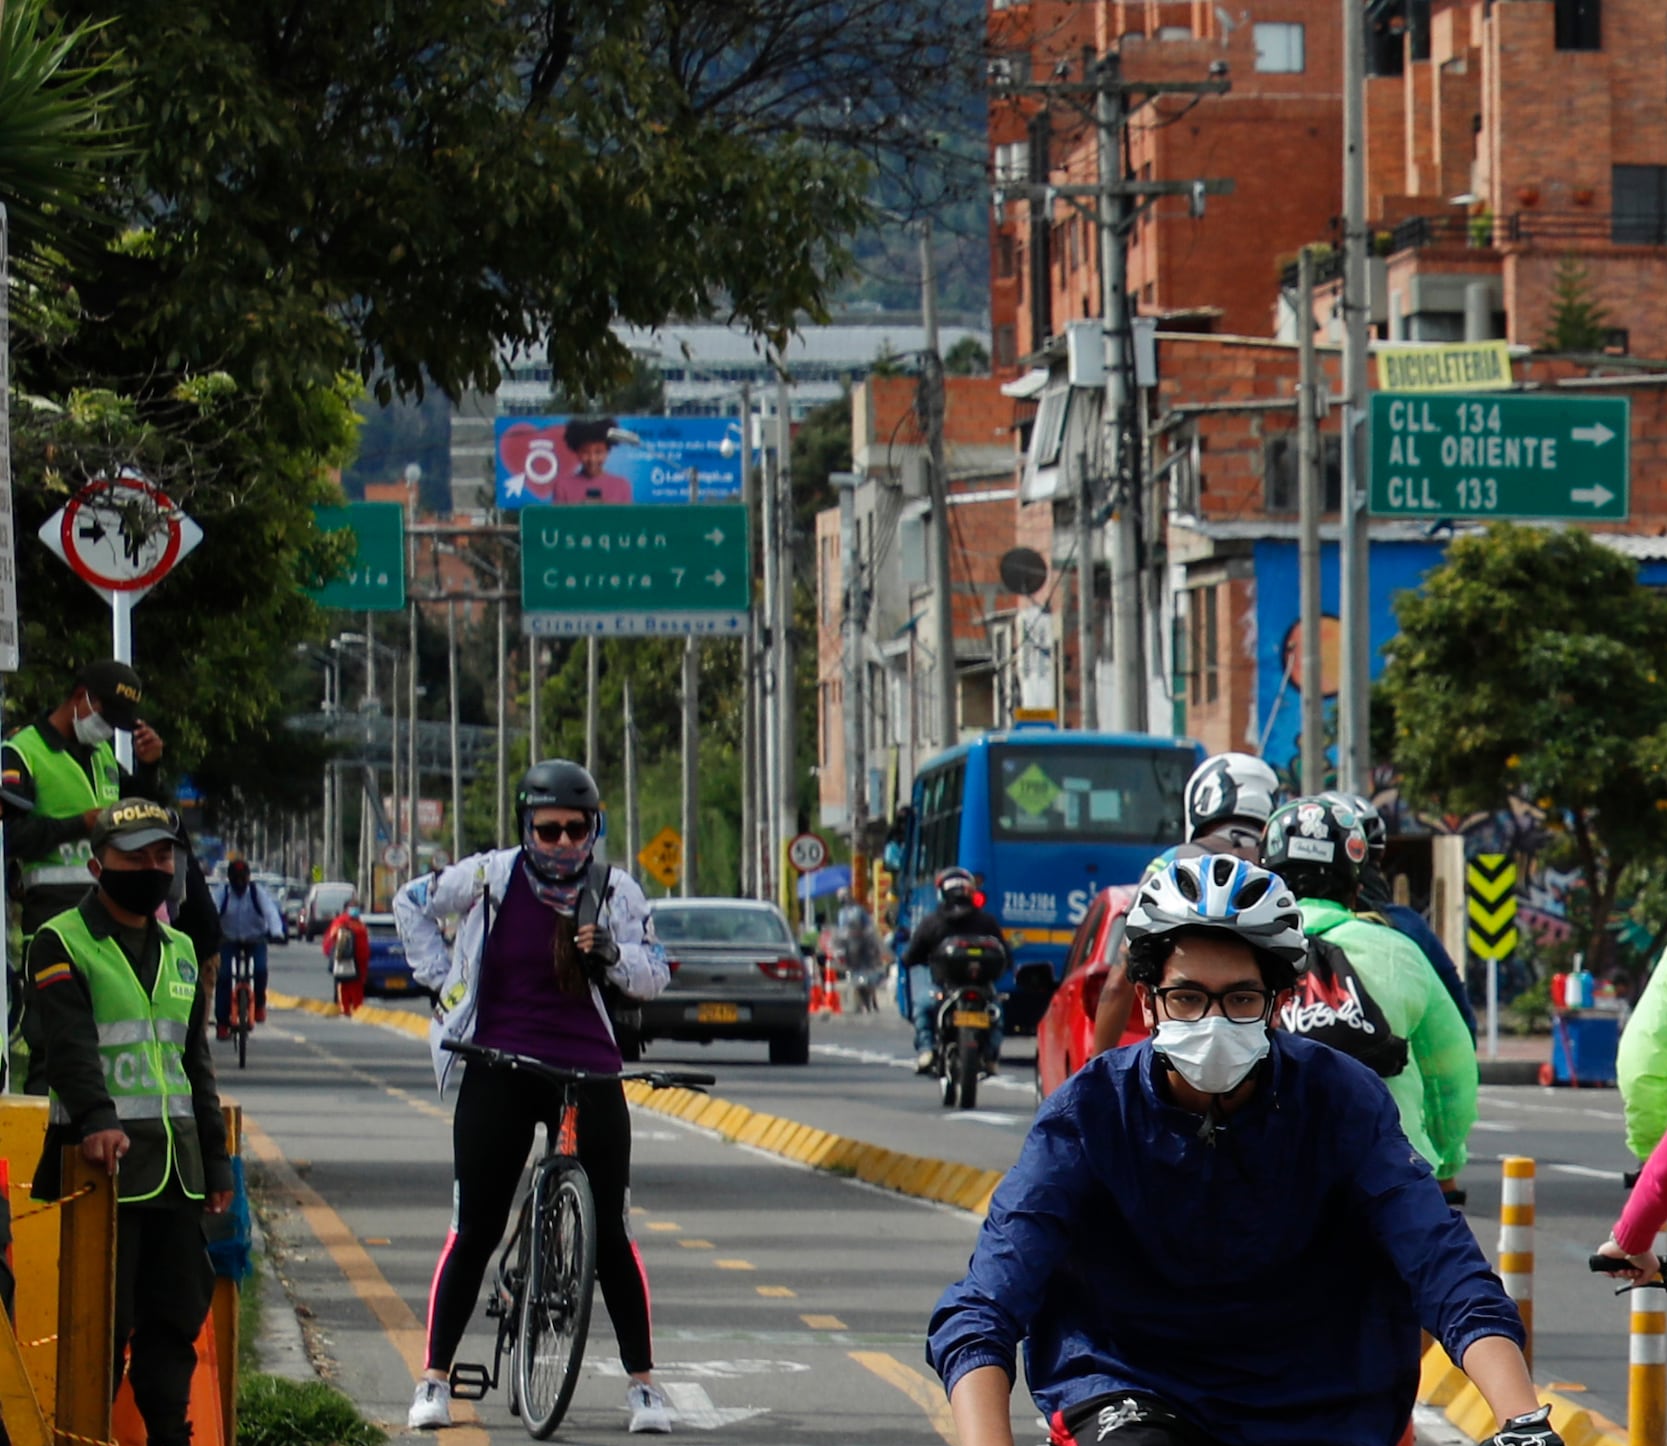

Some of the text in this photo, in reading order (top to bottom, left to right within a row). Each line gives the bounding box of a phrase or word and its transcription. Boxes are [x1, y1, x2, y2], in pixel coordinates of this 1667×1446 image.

[1386, 350, 1504, 387] BICICLETERIA
[1388, 401, 1501, 433] CLL. 134
[1389, 435, 1557, 469] AL ORIENTE
[1388, 477, 1498, 509] CLL. 133
[542, 528, 667, 552] Usaquén
[543, 568, 686, 588] Carrera 7
[796, 842, 820, 862] 50
